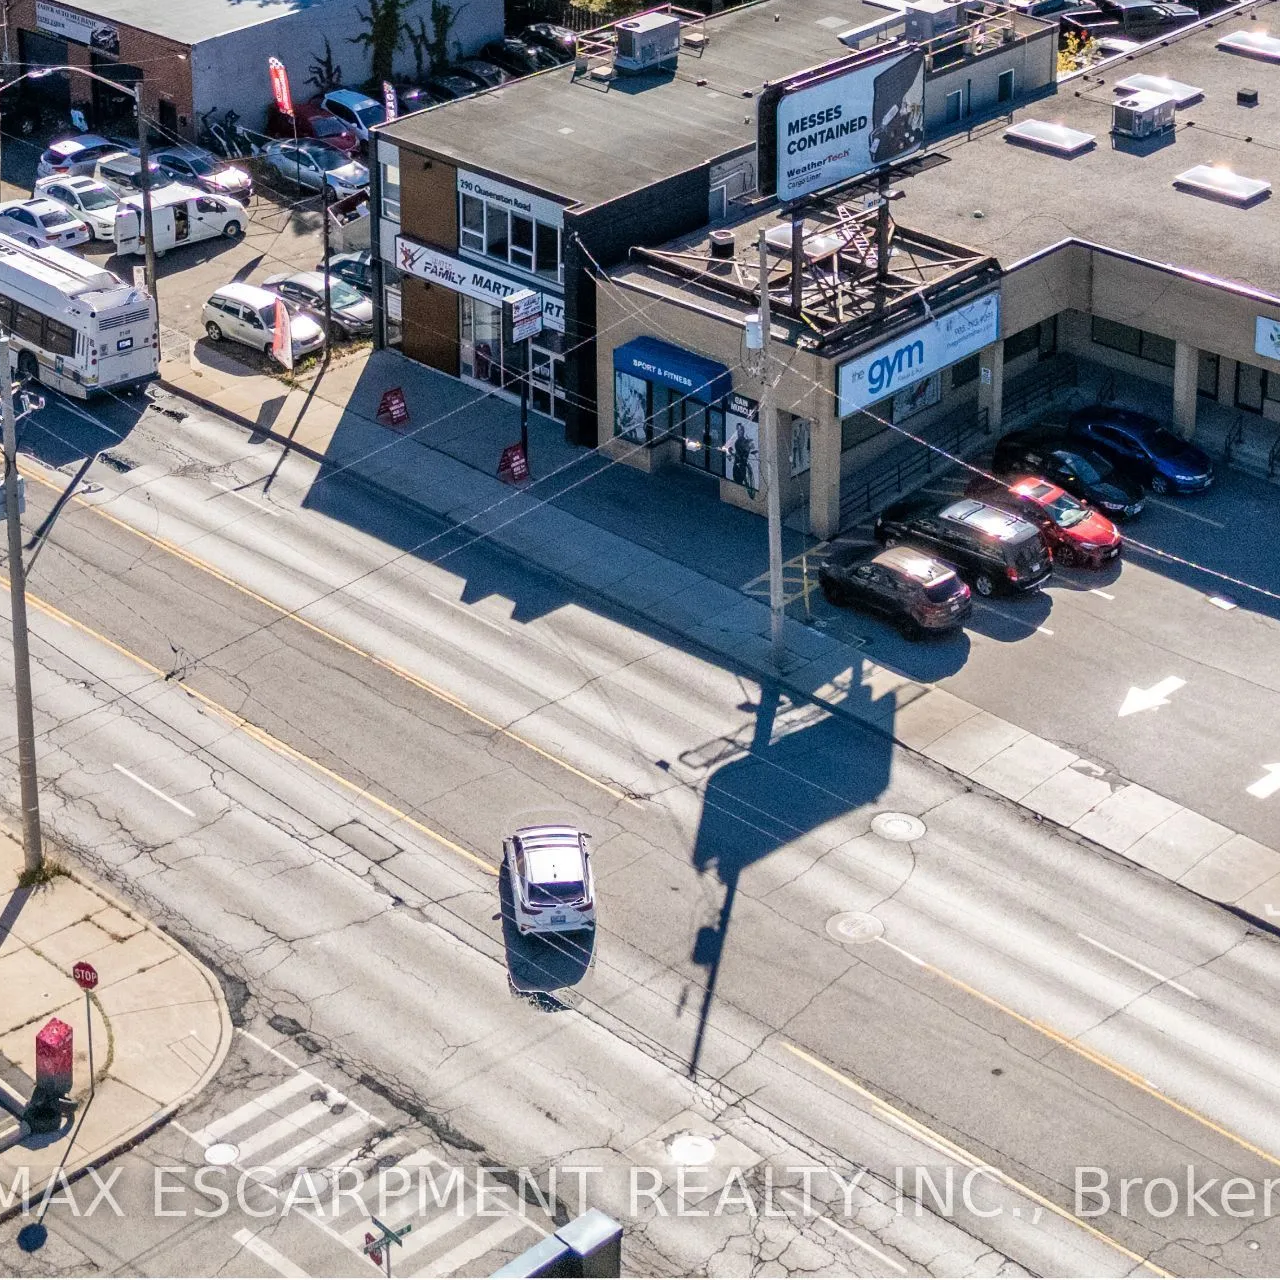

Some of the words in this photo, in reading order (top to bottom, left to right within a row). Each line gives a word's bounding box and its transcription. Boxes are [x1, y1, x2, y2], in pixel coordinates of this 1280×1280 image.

[787, 105, 842, 136] MESSES
[786, 115, 868, 155] CONTAINED
[786, 149, 850, 178] WeatherTech
[787, 178, 806, 190] Cargo
[807, 172, 822, 184] Liner
[460, 179, 473, 191] 290
[474, 184, 513, 206] Queenston
[514, 198, 531, 212] Road
[423, 261, 467, 286] FAMILY
[632, 359, 656, 373] SPORT
[657, 368, 662, 376] &
[663, 370, 693, 387] FITNESS
[851, 369, 865, 384] the
[868, 339, 924, 394] gym
[734, 396, 749, 407] GAIN
[75, 968, 97, 983] STOP
